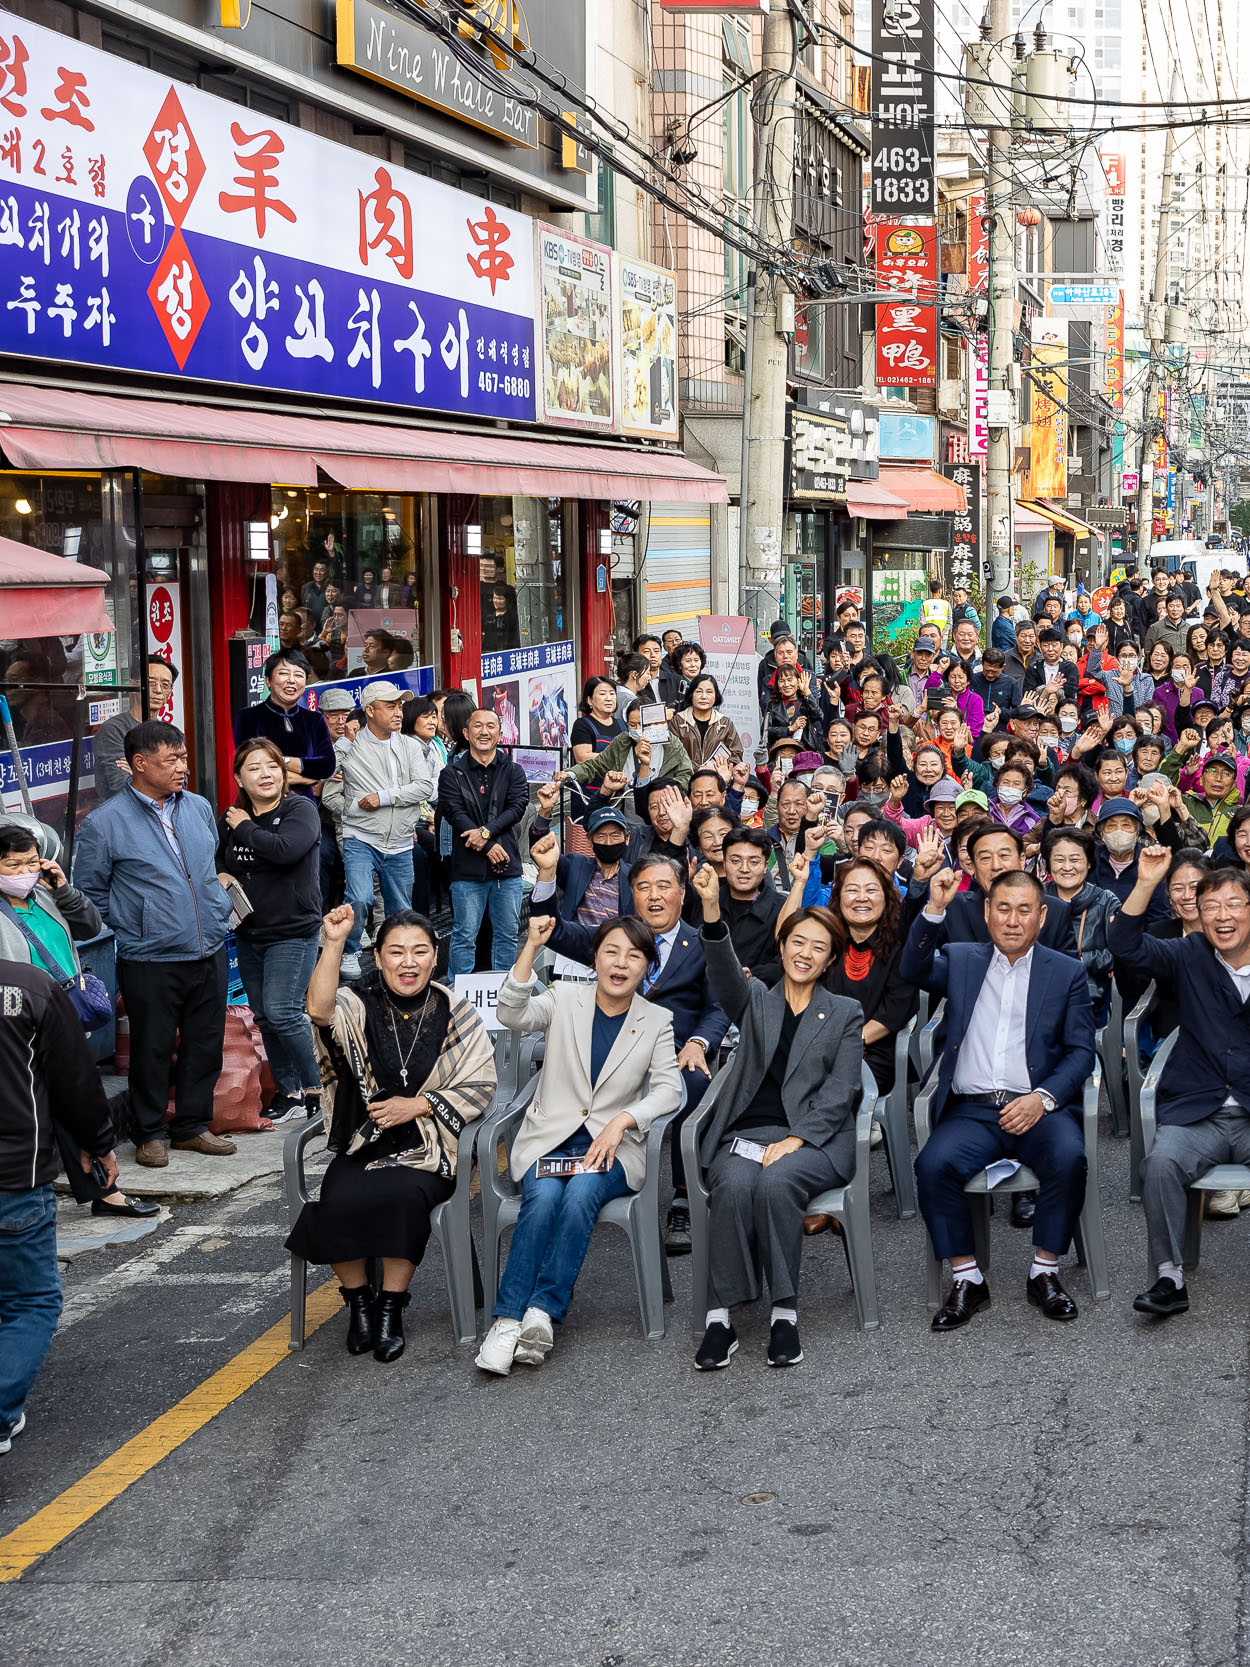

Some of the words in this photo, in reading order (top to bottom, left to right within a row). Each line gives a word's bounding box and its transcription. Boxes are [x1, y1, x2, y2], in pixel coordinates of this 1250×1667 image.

[366, 16, 424, 83] Nine
[502, 97, 533, 134] Bar
[874, 148, 932, 172] 463-
[874, 178, 930, 202] 1833
[131, 194, 156, 244] 구
[219, 121, 514, 295] 羊肉串
[544, 240, 558, 260] KBS
[627, 271, 637, 288] SBS
[229, 255, 471, 399] 양꼬치구이
[478, 371, 530, 399] 467-6880
[151, 601, 172, 625] 원조
[465, 988, 499, 1009] 내빈
